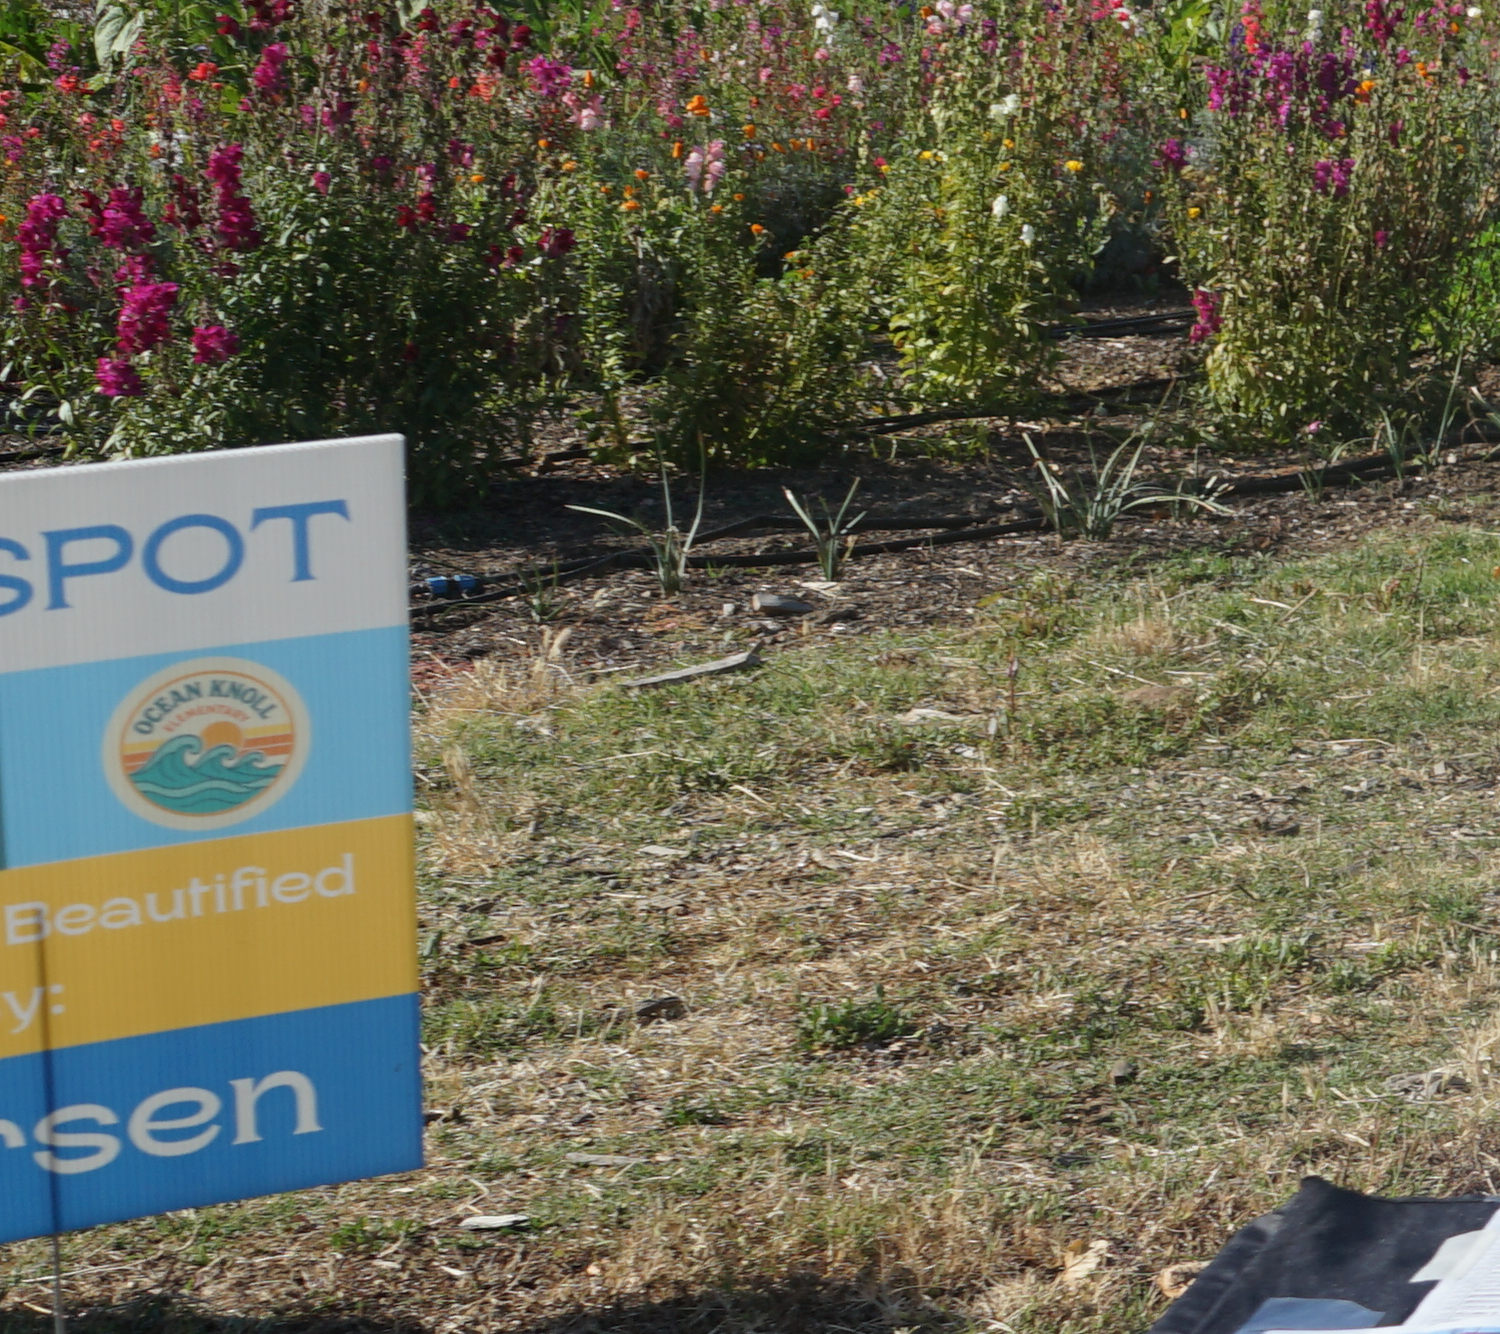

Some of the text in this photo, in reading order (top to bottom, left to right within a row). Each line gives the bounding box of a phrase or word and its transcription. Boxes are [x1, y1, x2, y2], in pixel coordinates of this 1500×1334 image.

[133, 678, 281, 736] OCEAN KNOLL
[162, 703, 252, 733] ELEMENTARY
[3, 852, 357, 947] Beautified
